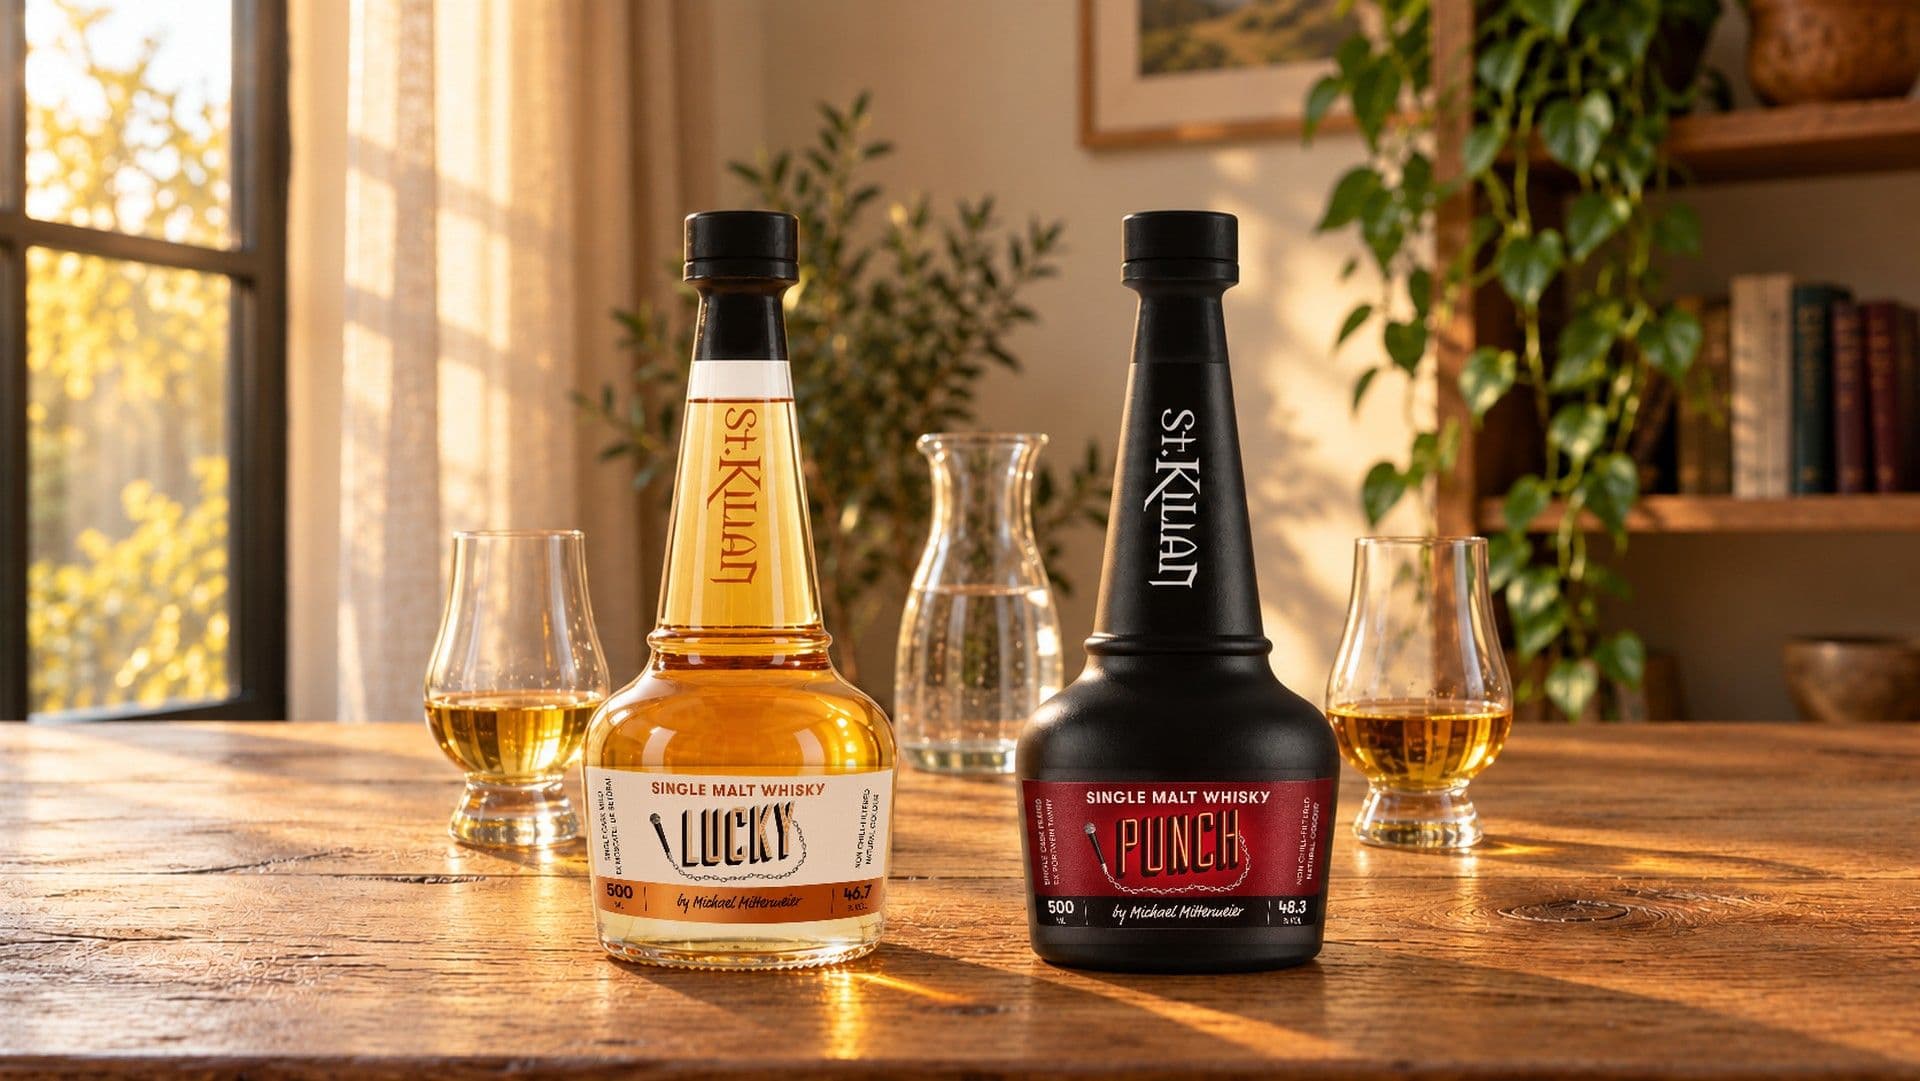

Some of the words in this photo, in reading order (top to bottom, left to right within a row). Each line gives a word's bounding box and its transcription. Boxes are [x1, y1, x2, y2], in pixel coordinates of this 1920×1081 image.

[651, 782, 706, 795] SINGLE
[712, 784, 756, 797] MALT
[761, 783, 825, 797] WHISKY
[1086, 791, 1146, 804] SINGLE
[1152, 791, 1197, 804] MALT
[1203, 791, 1270, 804] WHISKY
[682, 801, 795, 868] LUCKY
[1116, 809, 1239, 879] PUNCH
[606, 882, 633, 899] 500
[843, 884, 872, 900] 46.7
[677, 893, 690, 913] by
[693, 894, 737, 909] Michael
[738, 893, 802, 909] Mittermeier
[1048, 900, 1074, 914] 500
[1278, 900, 1307, 914] 48.3
[1112, 904, 1127, 926] by
[1129, 904, 1176, 919] Michael
[1179, 903, 1244, 919] Mittermeier
